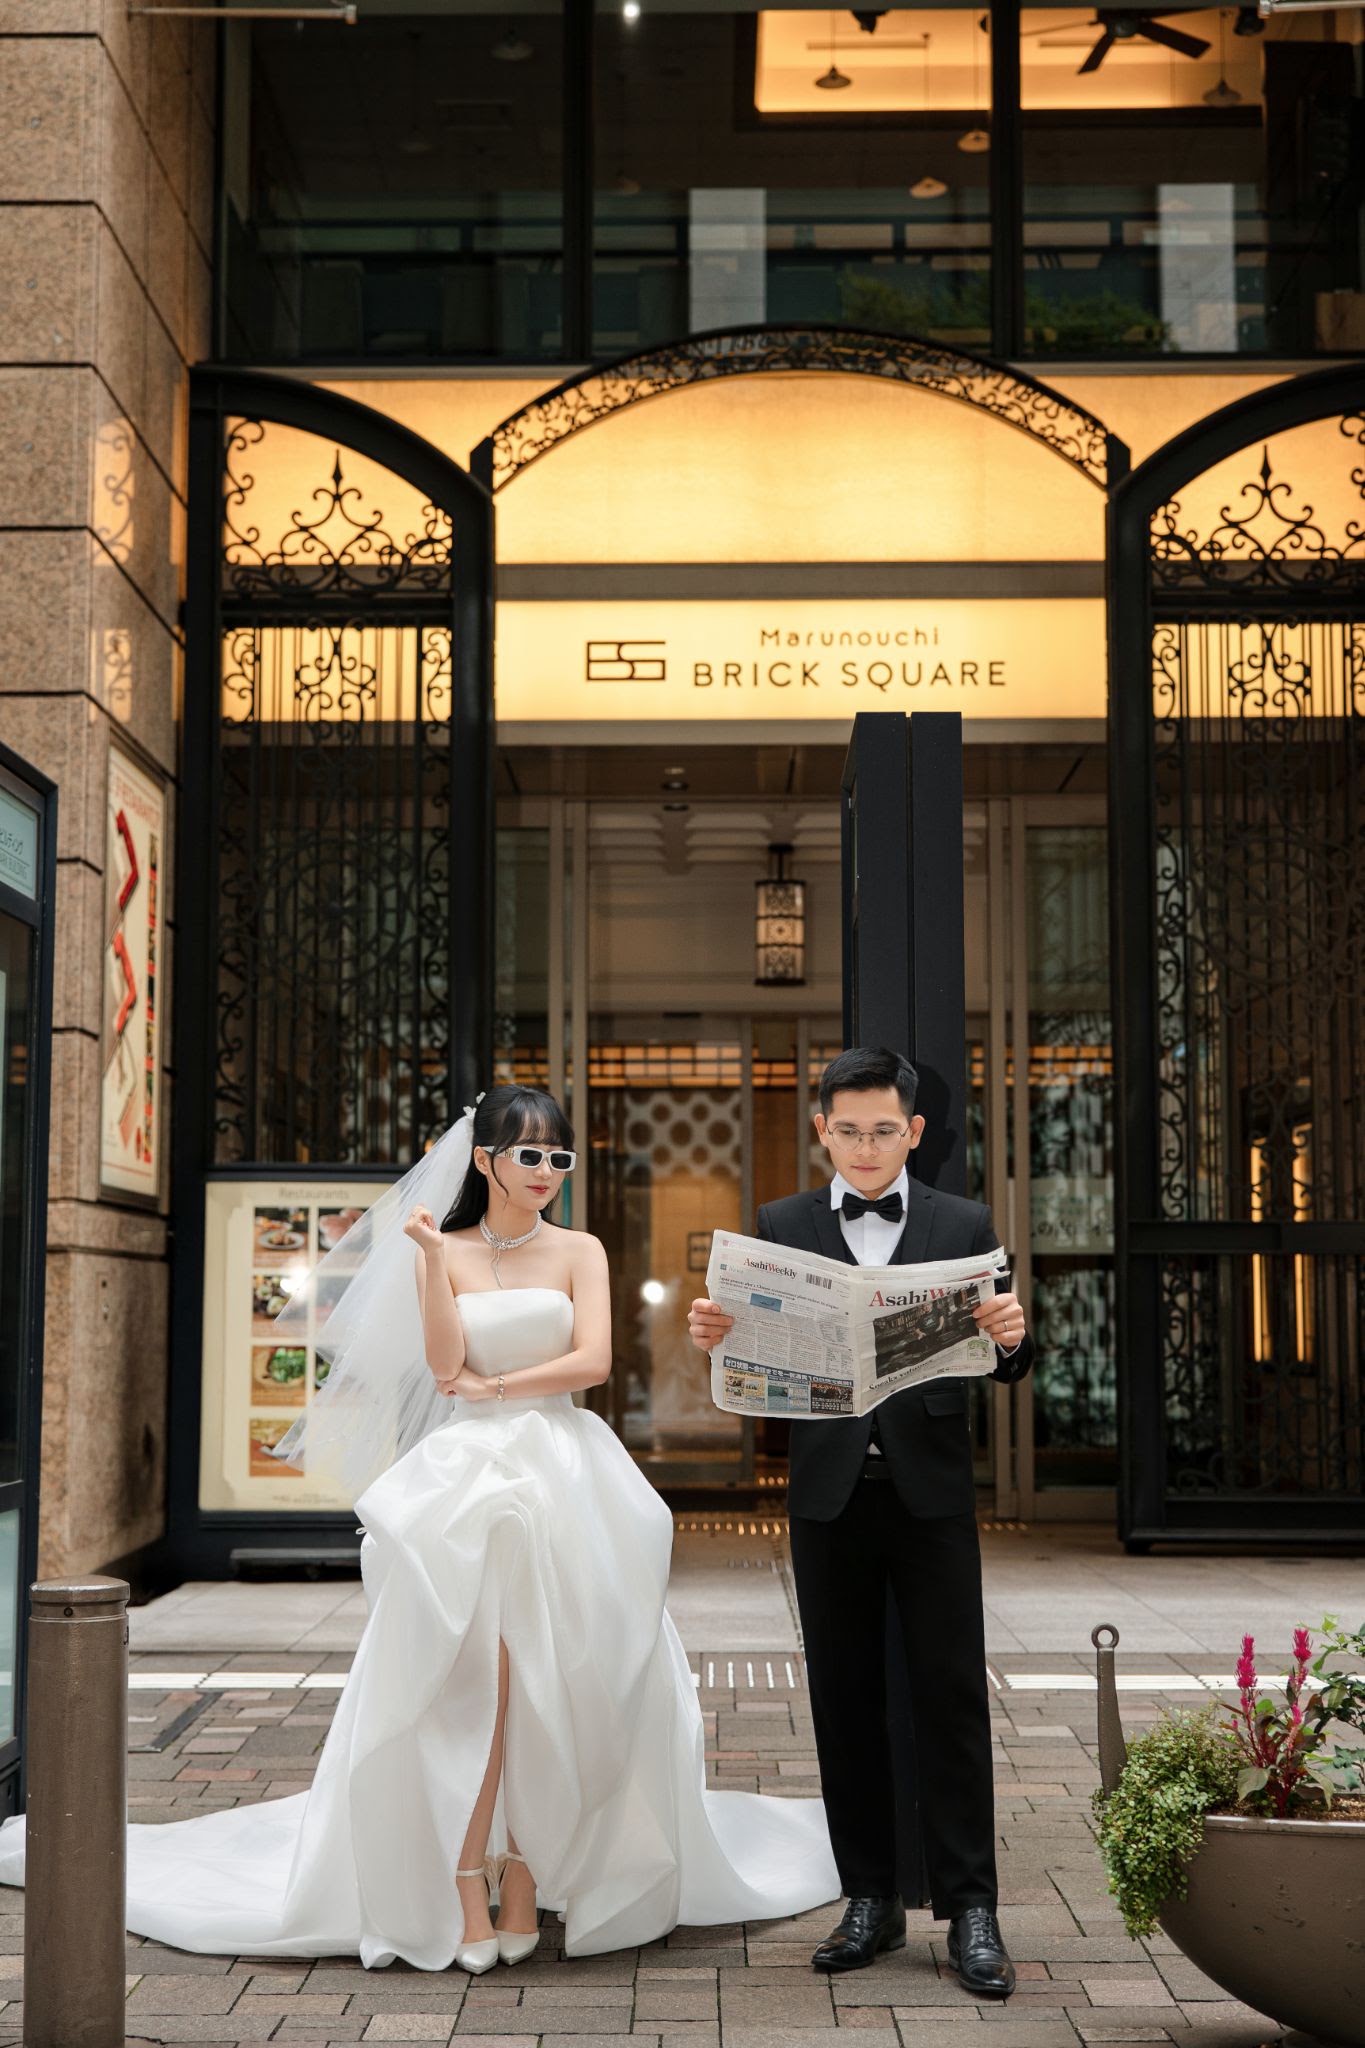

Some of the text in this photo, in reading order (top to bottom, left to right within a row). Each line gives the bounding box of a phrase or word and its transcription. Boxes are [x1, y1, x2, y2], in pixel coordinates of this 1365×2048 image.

[760, 629, 940, 648] Marunouchi
[694, 661, 1006, 692] BRICK SQUARE
[279, 1186, 350, 1200] Restaurants
[743, 1257, 798, 1280] AsahiWeekly
